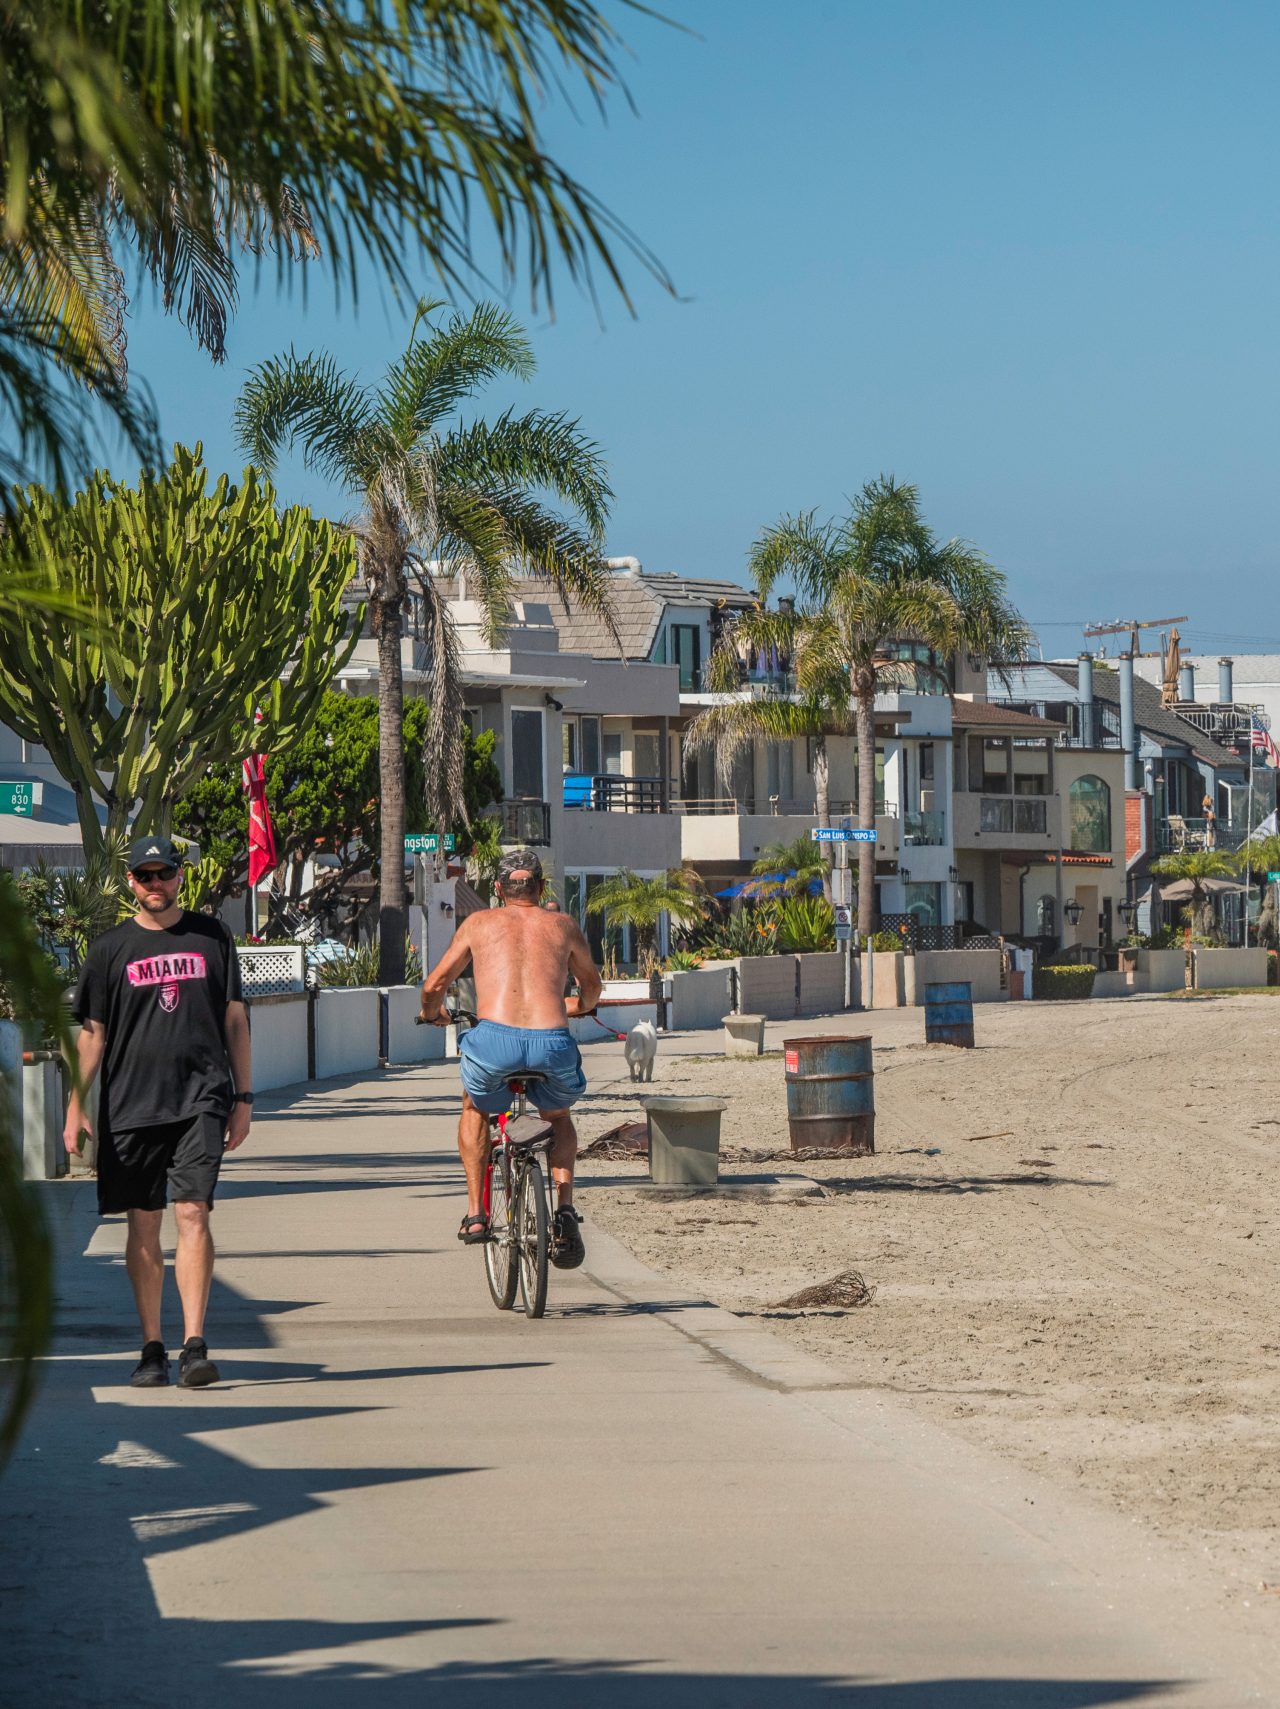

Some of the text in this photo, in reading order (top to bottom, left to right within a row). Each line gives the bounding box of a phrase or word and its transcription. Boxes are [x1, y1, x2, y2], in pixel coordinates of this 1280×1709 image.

[16, 785, 24, 794] CT
[11, 795, 28, 804] 830
[138, 958, 195, 979] MIAMI
